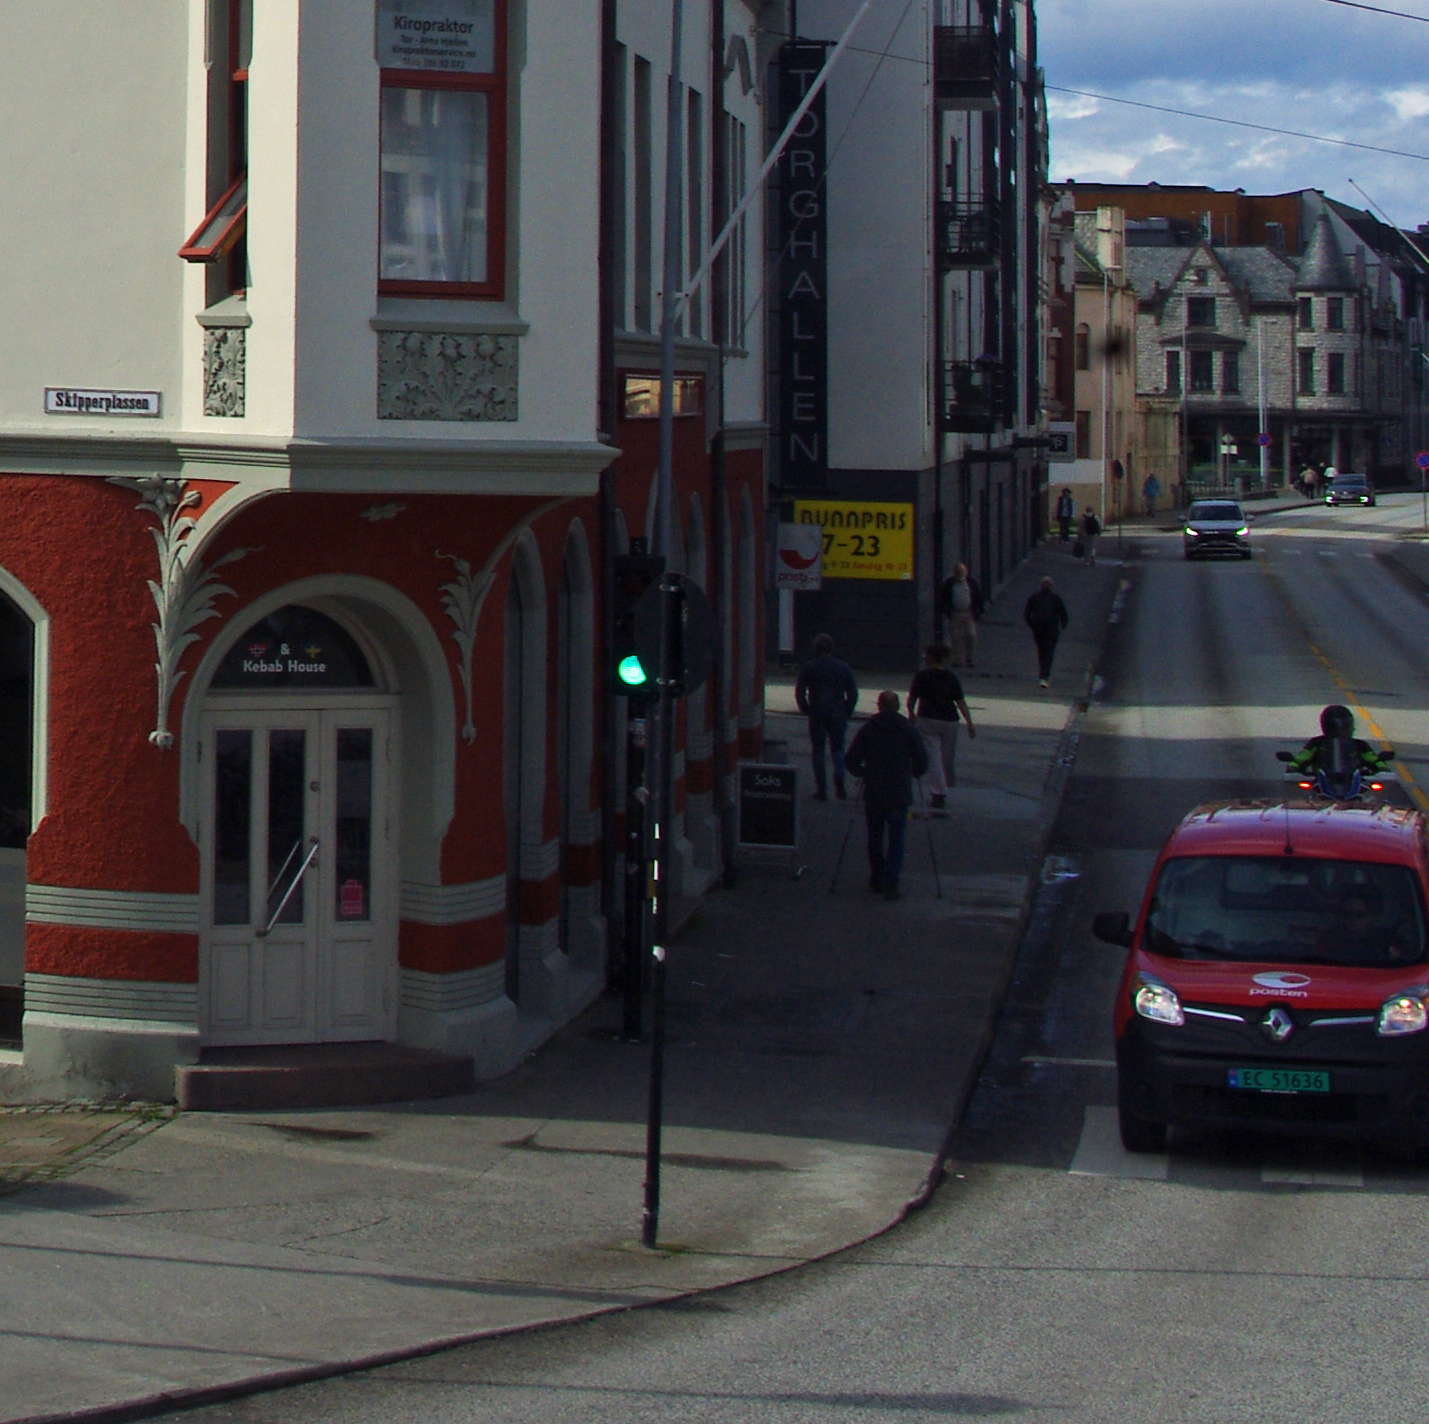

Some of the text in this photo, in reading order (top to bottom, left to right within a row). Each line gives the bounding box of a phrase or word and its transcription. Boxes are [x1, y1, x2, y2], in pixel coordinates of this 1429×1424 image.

[394, 16, 474, 34] Kiropraktor
[787, 69, 819, 462] TORGHALLEN
[55, 391, 150, 412] Skipperplassen
[243, 659, 326, 672] Kebab House
[1249, 988, 1308, 998] posten
[1243, 1071, 1324, 1089] EC 51636
